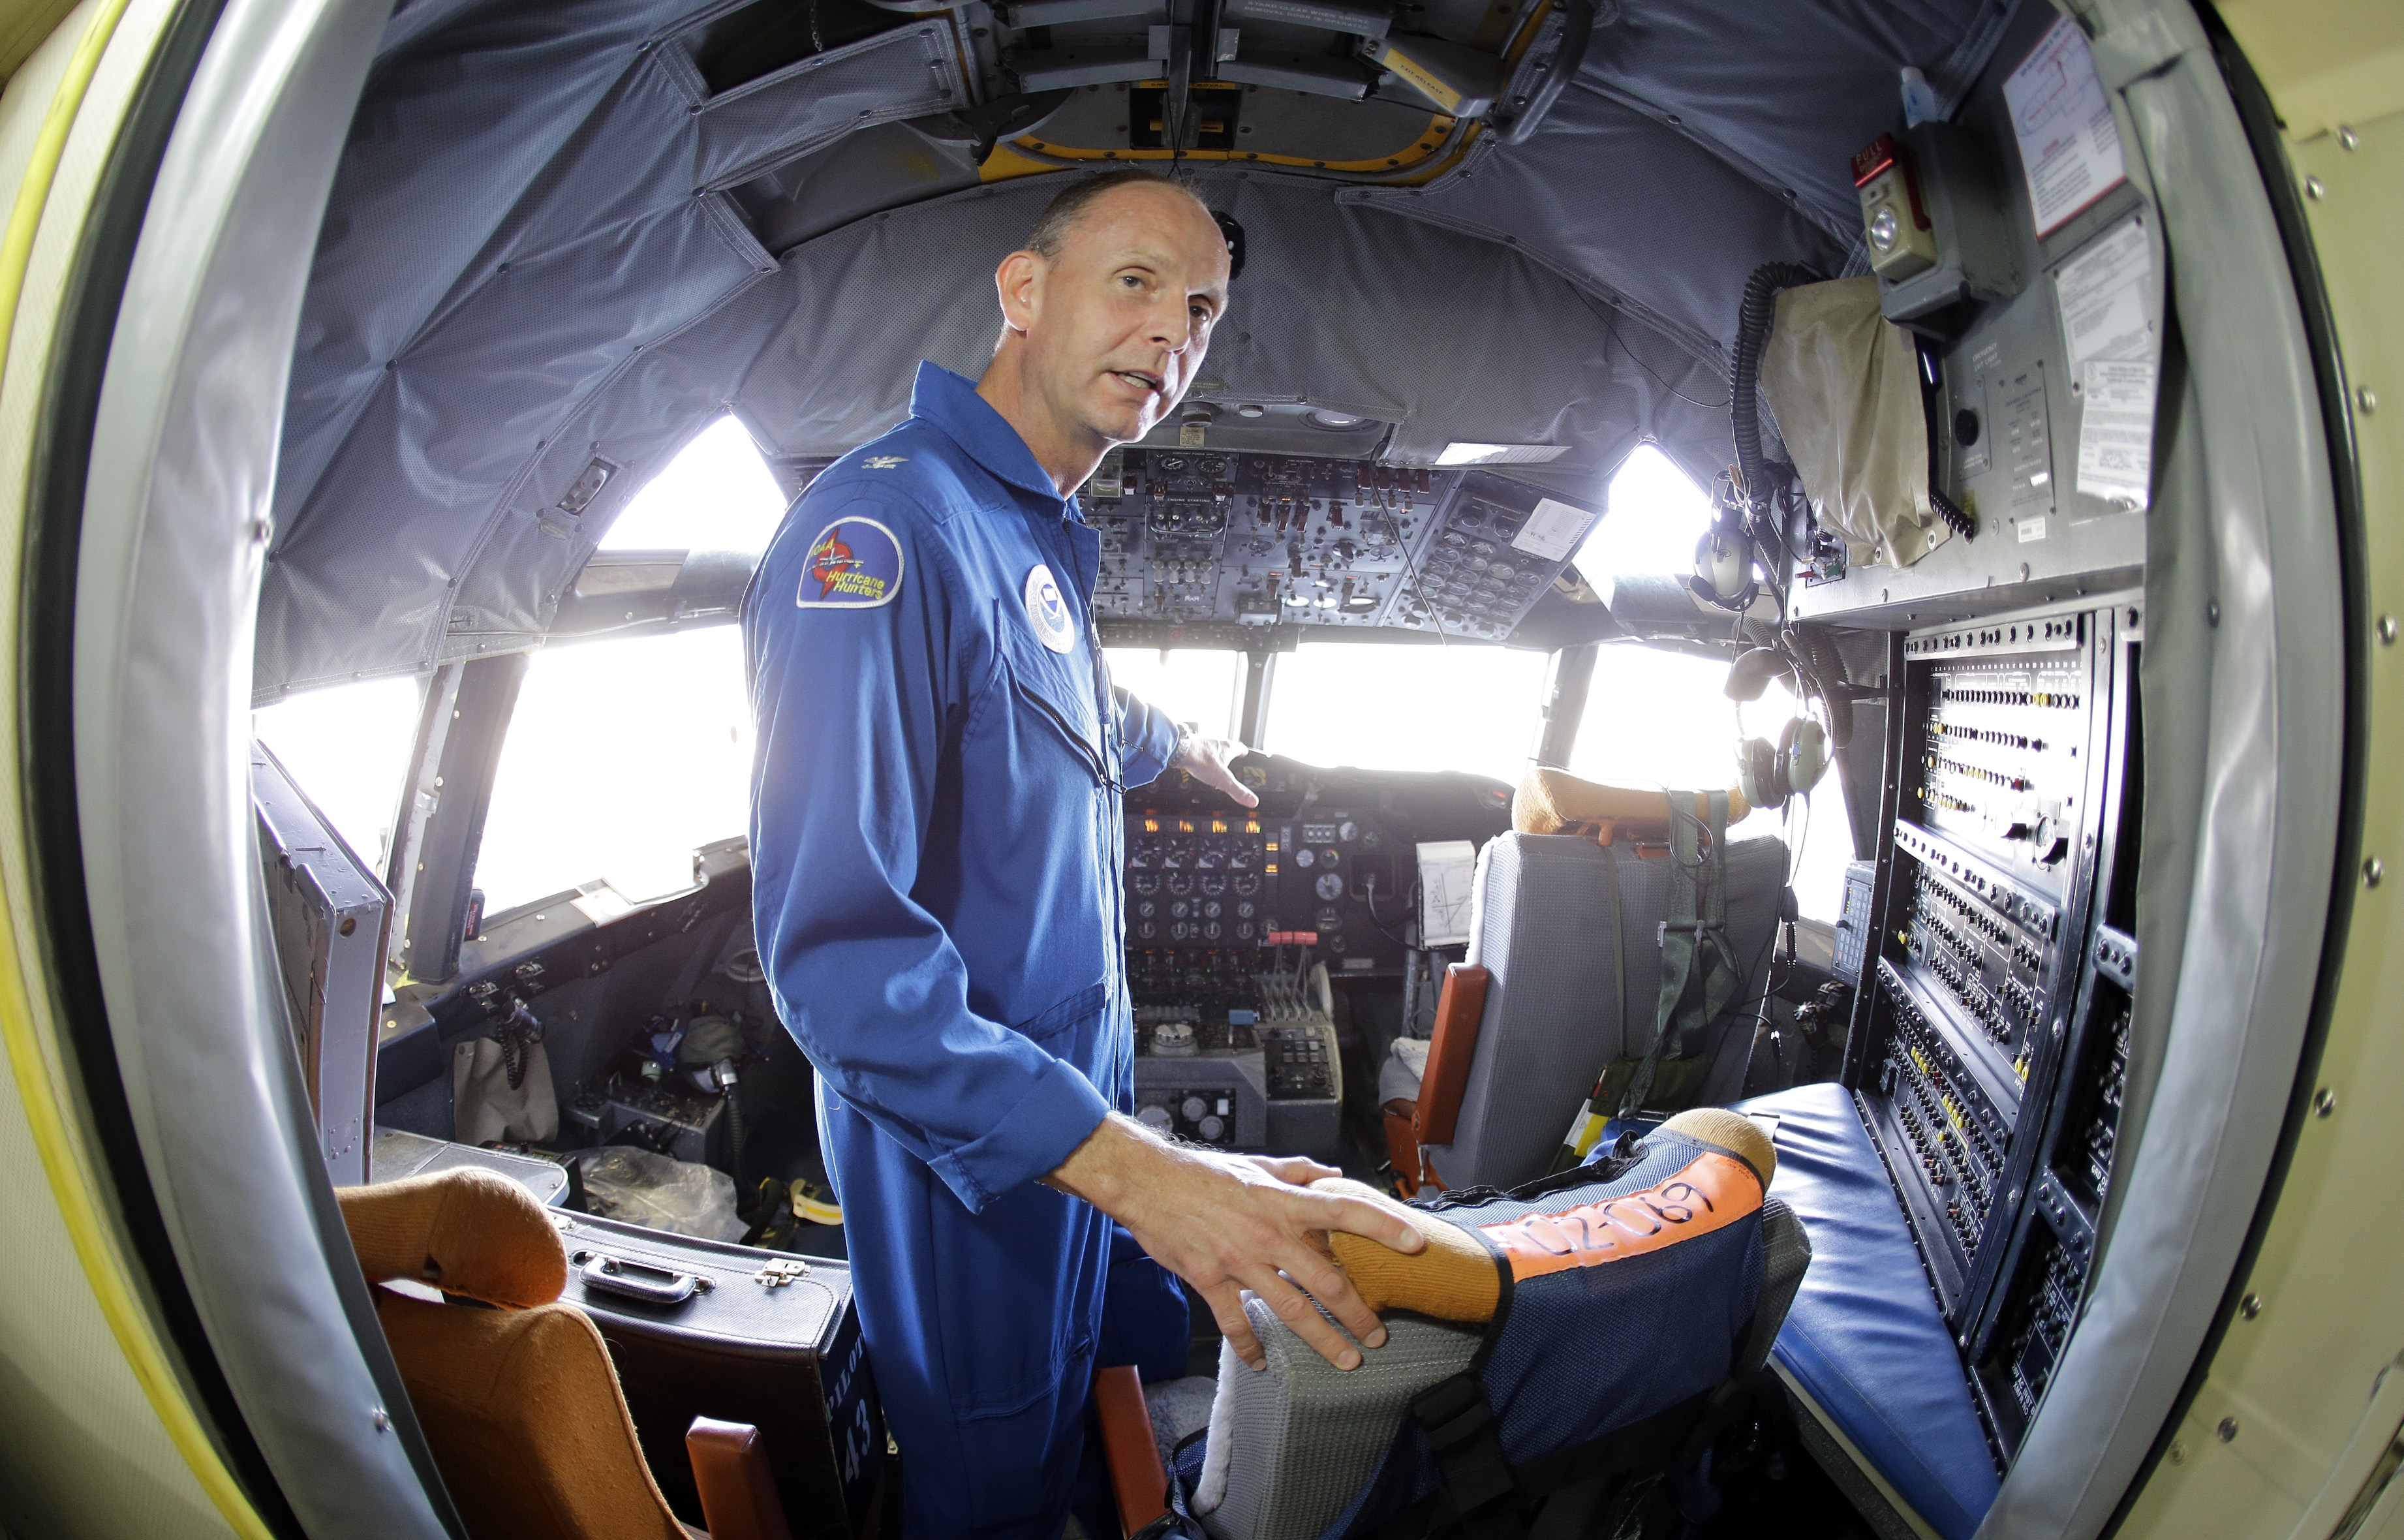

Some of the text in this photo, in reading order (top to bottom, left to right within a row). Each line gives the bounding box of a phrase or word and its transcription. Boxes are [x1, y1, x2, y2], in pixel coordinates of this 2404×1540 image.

[1244, 6, 1284, 16] REMOVAL
[1287, 11, 1311, 20] DOOR
[1324, 18, 1369, 30] OPERATED
[1310, 10, 1336, 18] WHEN
[1339, 15, 1369, 24] SMOKE
[1400, 65, 1443, 95] EXIT RELEASE
[1856, 140, 1883, 167] PULL
[825, 570, 886, 589] Hurricane
[833, 580, 884, 600] Hunters
[2014, 1077, 2023, 1090] APU
[2091, 1164, 2102, 1180] GRD
[2097, 1183, 2104, 1196] DC
[1520, 1182, 1715, 1256] 02-069
[825, 1331, 865, 1424] PILOT
[2012, 1381, 2024, 1404] XMFR
[2017, 1377, 2024, 1389] AC
[2022, 1387, 2033, 1408] INST
[845, 1398, 872, 1485] 43
